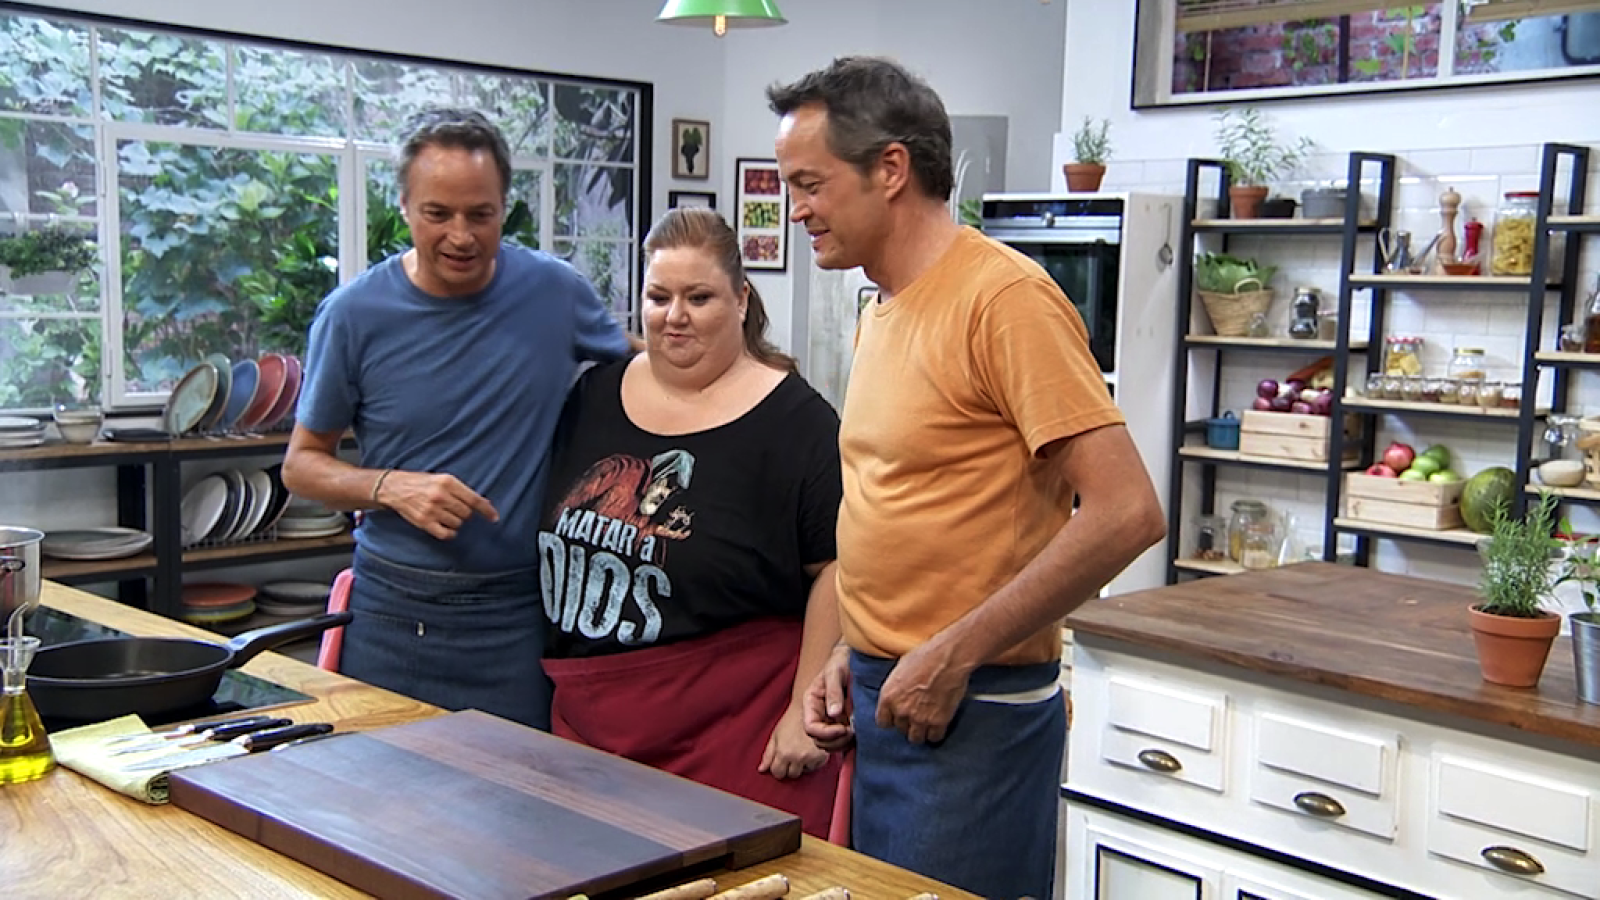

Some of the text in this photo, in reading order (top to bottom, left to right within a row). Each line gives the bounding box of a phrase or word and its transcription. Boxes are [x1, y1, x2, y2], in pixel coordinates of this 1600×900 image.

[555, 507, 656, 561] MATAR a
[538, 531, 671, 645] DIOS
